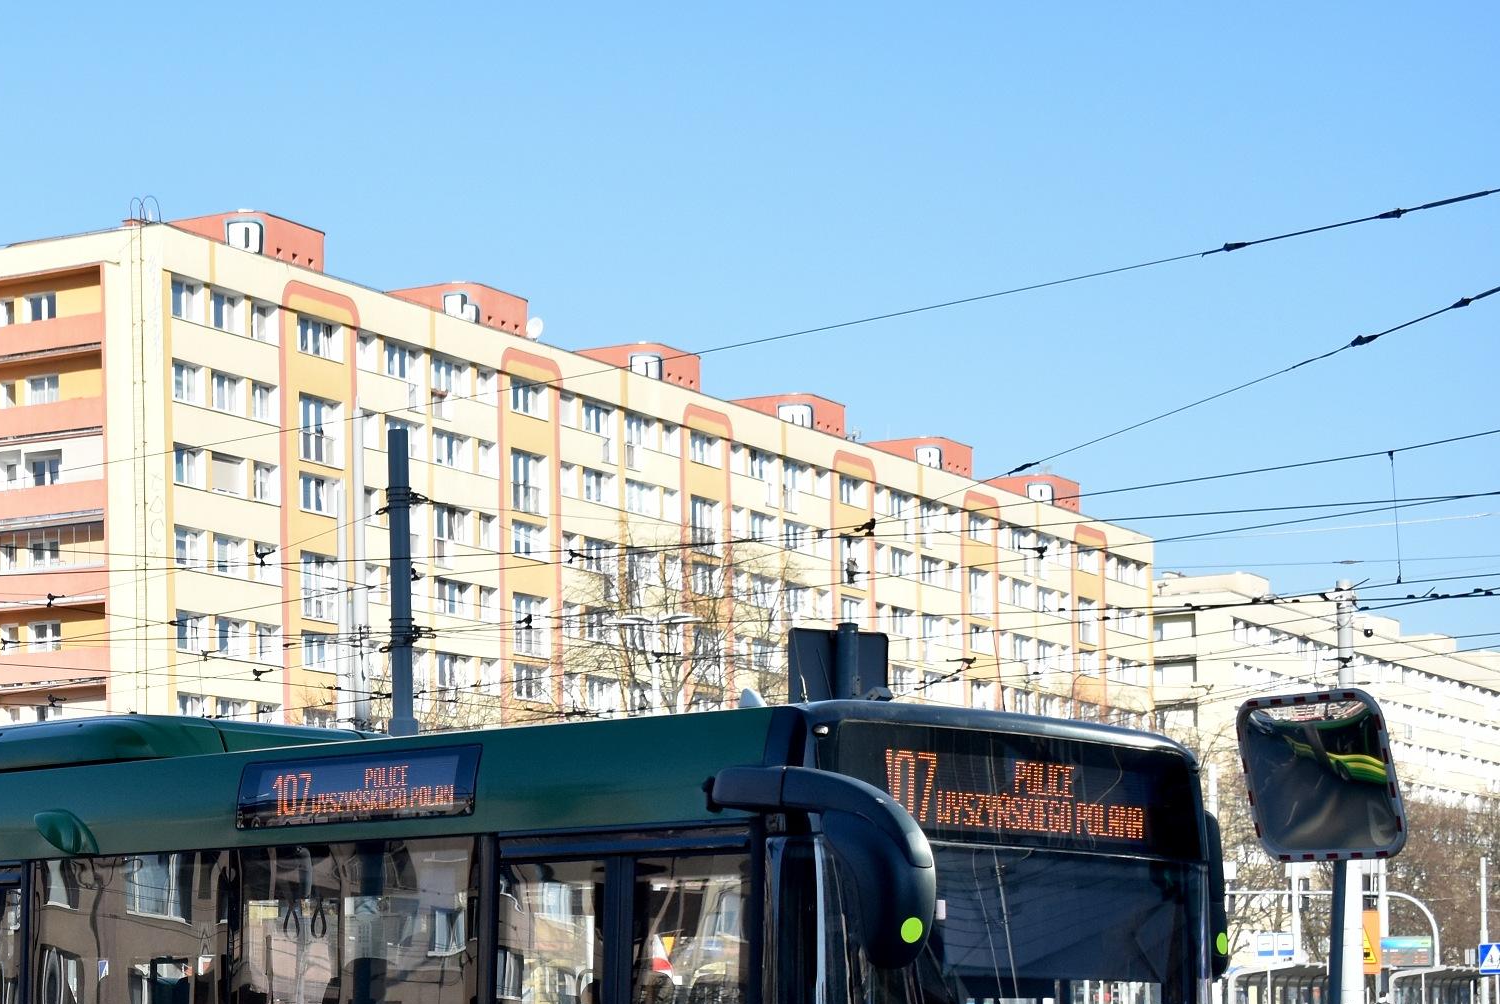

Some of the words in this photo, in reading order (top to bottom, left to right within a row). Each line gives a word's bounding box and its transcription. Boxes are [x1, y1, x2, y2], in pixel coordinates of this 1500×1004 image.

[271, 773, 312, 817] 107
[364, 765, 409, 789] POLICE
[1014, 761, 1076, 798] POLICE
